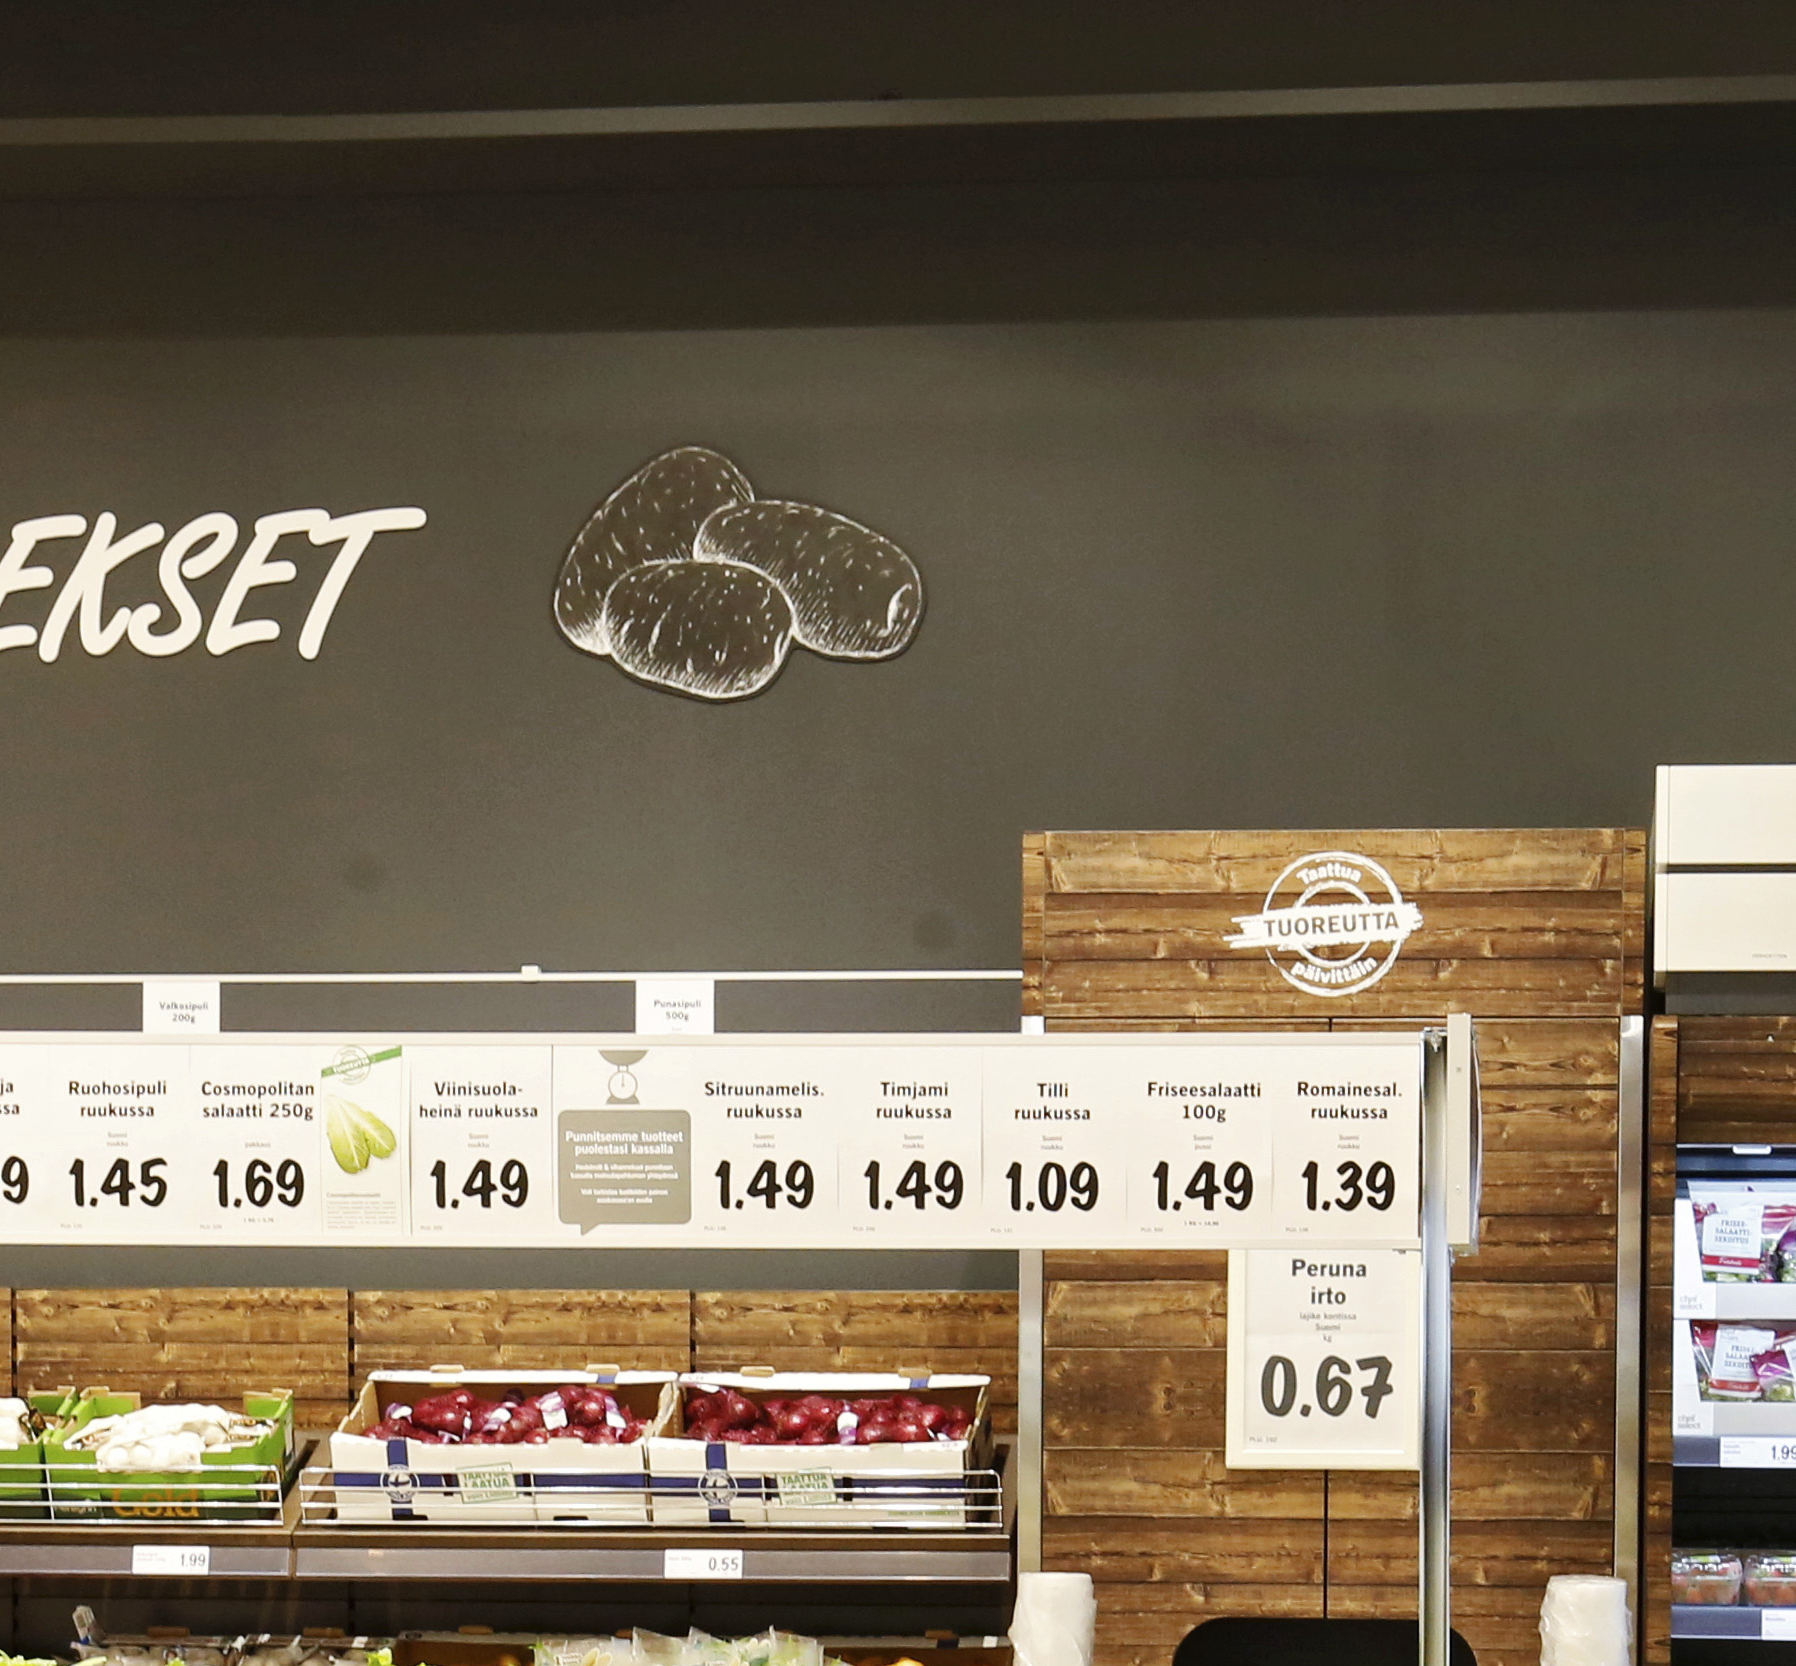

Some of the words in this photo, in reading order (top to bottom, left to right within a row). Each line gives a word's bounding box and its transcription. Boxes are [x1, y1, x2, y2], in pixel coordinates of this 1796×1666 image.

[1296, 863, 1362, 884] Taattua
[1264, 911, 1399, 937] TUOREUTTA
[653, 999, 702, 1012] Punasipuli
[172, 1013, 195, 1024] 200g
[665, 1011, 689, 1023] 500g
[68, 1080, 167, 1099] Ruohosipuli
[201, 1080, 315, 1100] Cosmopolitan
[434, 1080, 523, 1097] Viinisuola-
[704, 1081, 825, 1097] Sitruunamelis.
[880, 1082, 949, 1100] Timjami
[1037, 1082, 1068, 1098] Tilli
[1147, 1081, 1262, 1097] Friseesalaatti
[1297, 1081, 1402, 1097] Romainesal.
[80, 1103, 155, 1118] ruukussa
[202, 1103, 263, 1119] salaatti
[269, 1103, 314, 1121] 250g
[419, 1103, 462, 1118] heinä
[468, 1104, 538, 1118] ruukussa
[726, 1104, 802, 1119] ruukussa
[875, 1105, 952, 1120] ruukussa
[1014, 1106, 1091, 1121] ruukussa
[1182, 1105, 1226, 1122] 100g
[1310, 1105, 1388, 1120] ruukussa
[565, 1130, 639, 1142] Punnitsemme
[641, 1130, 684, 1142] tuotteet
[574, 1143, 628, 1157] puolestasi
[631, 1143, 674, 1155] kassalla
[69, 1157, 167, 1208] 1.45
[213, 1158, 305, 1208] 1.69
[430, 1159, 529, 1209] 1.49
[715, 1160, 814, 1210] 1.49
[864, 1160, 964, 1210] 1.49
[1005, 1161, 1099, 1212] 1.09
[1153, 1161, 1253, 1211] 1.49
[1302, 1161, 1395, 1211] 1.39
[1291, 1259, 1367, 1277] Peruna
[1310, 1286, 1347, 1305] irto
[1261, 1355, 1393, 1419] 0.67
[180, 1552, 206, 1569] 1.99
[707, 1556, 740, 1573] 0.55
